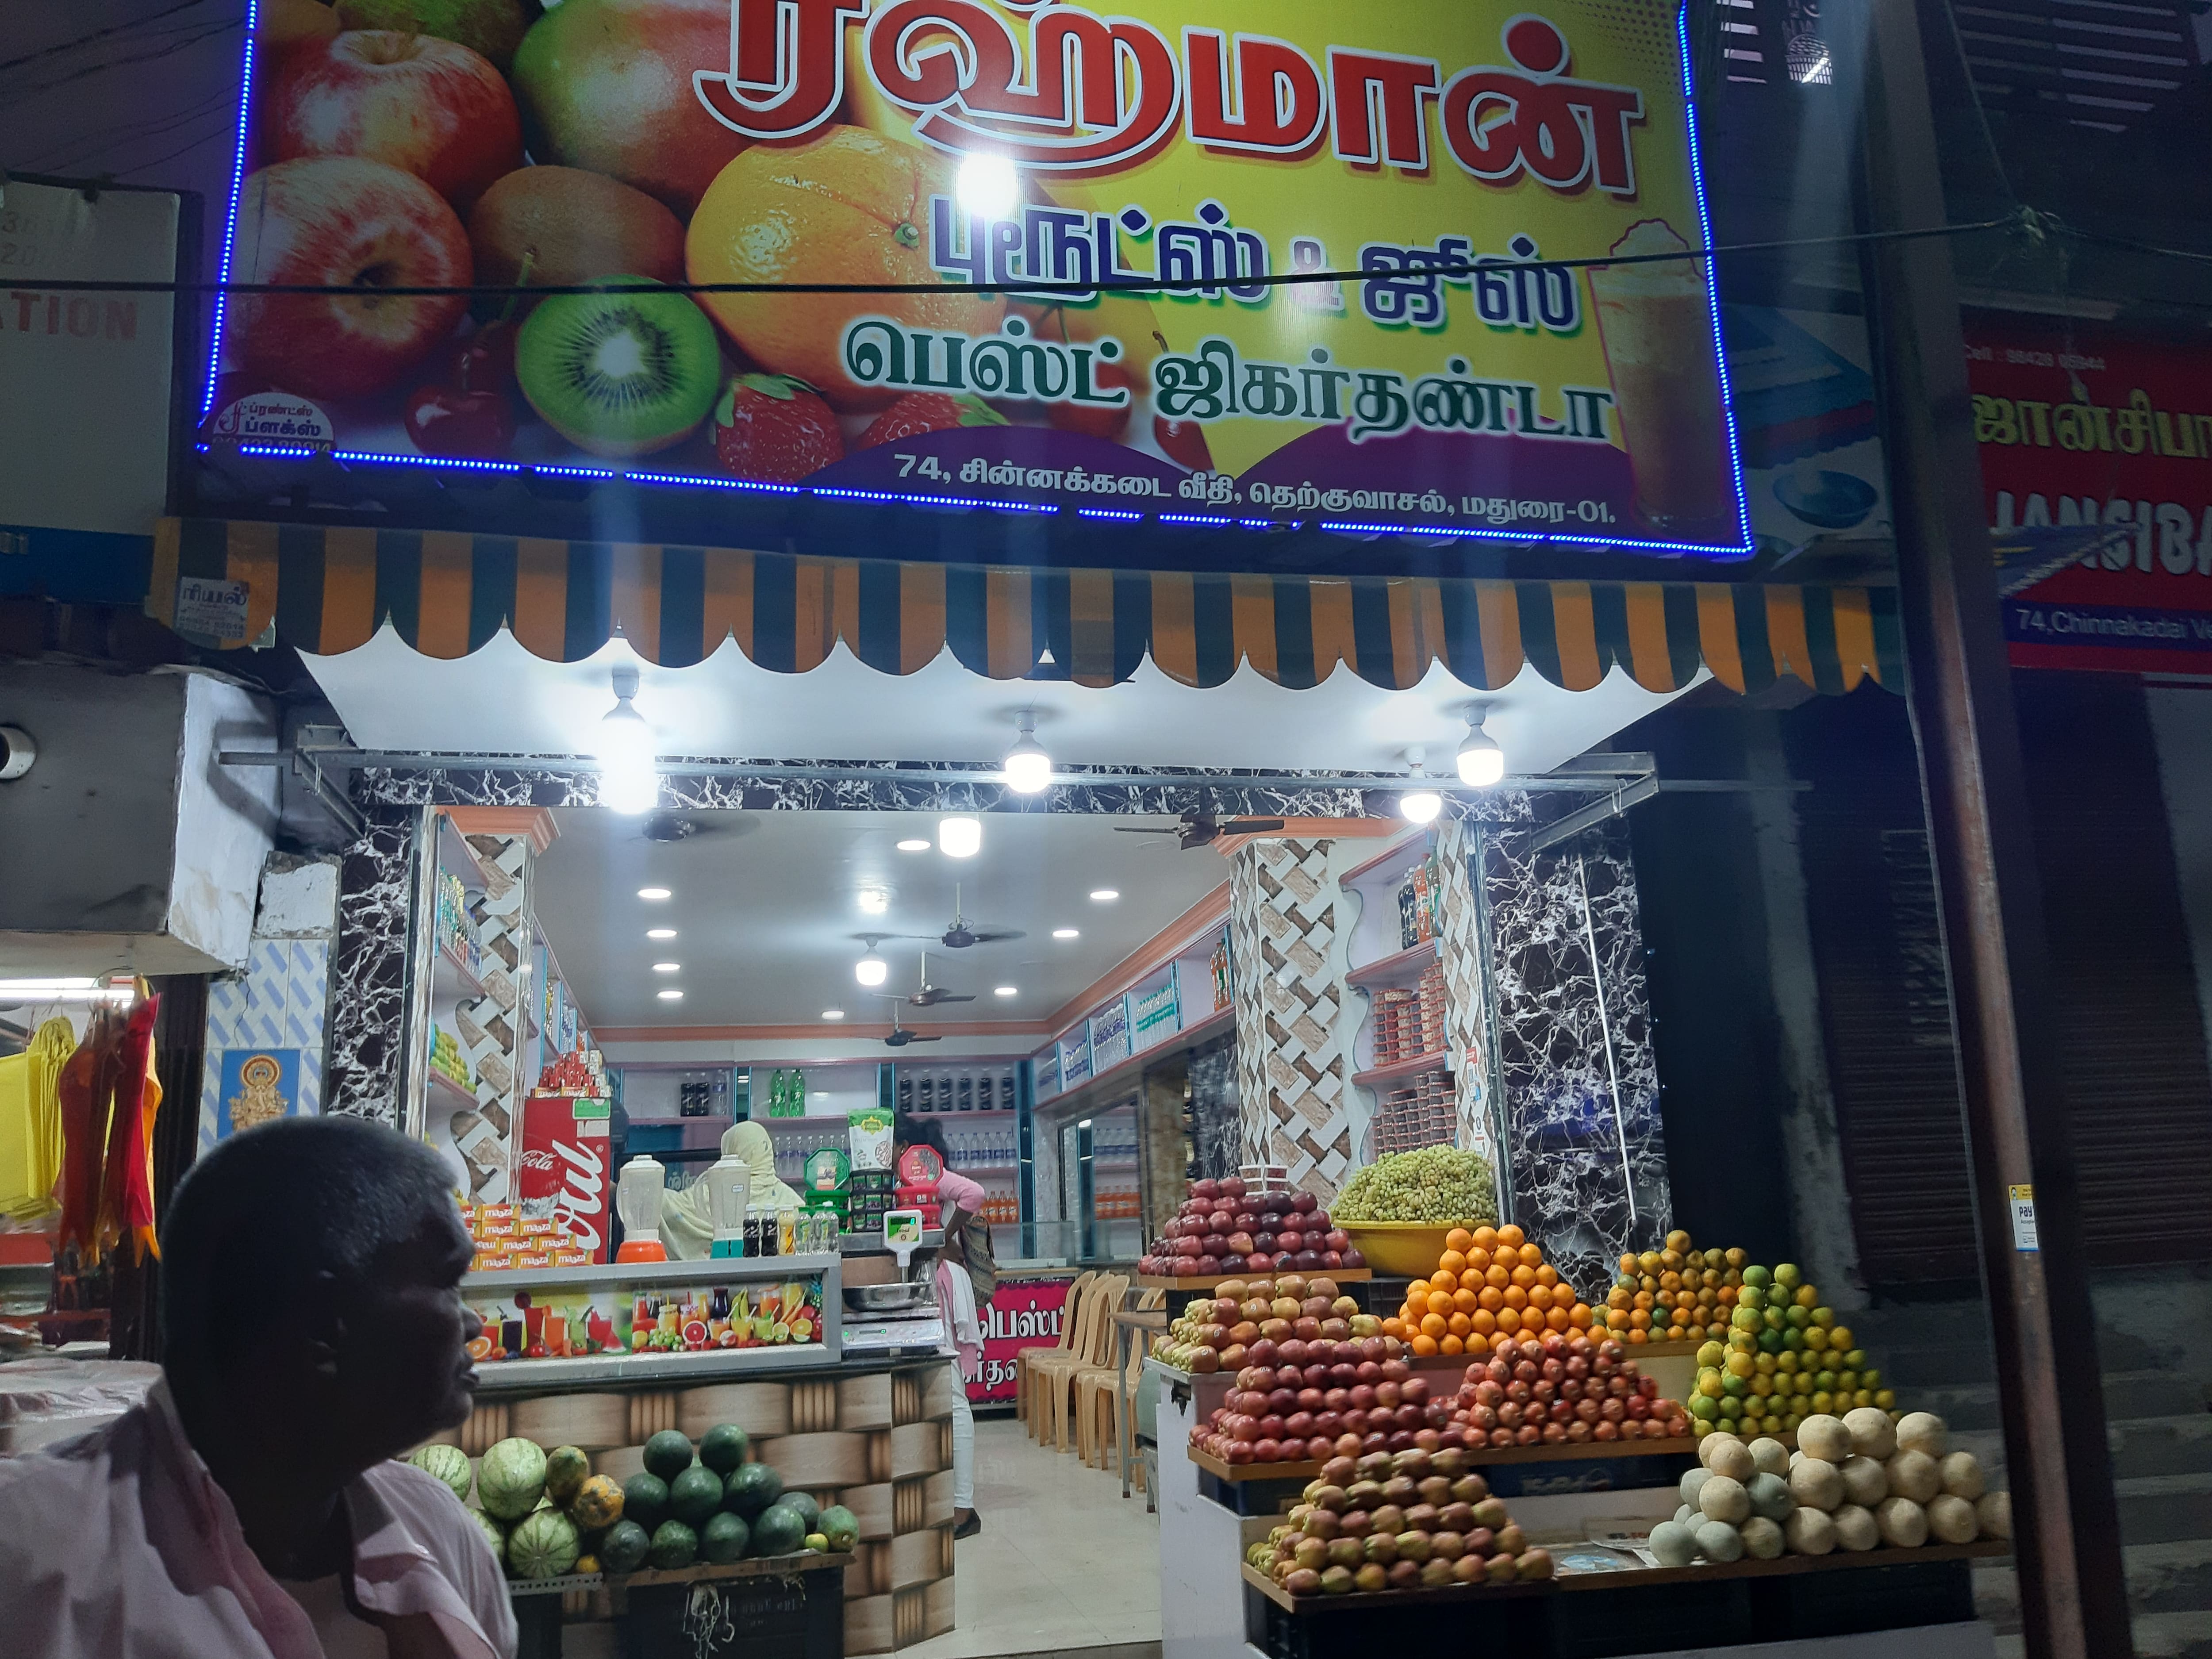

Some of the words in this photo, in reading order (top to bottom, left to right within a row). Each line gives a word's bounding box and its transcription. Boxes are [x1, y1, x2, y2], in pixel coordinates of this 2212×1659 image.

[0, 291, 137, 340] TION
[1290, 234, 1345, 311] &
[1359, 232, 1581, 331] ஜூஸ்
[843, 317, 1128, 405] பெஸ்ட்
[1153, 338, 1613, 442] ஜிகர்தண்டா
[894, 453, 952, 484] 74,
[959, 457, 1171, 497] சின்னக்கடை
[1178, 471, 1242, 507] வீதி,
[1249, 480, 1455, 516] தெற்குவாசல்,
[1462, 494, 1616, 524] மதுரை-01.
